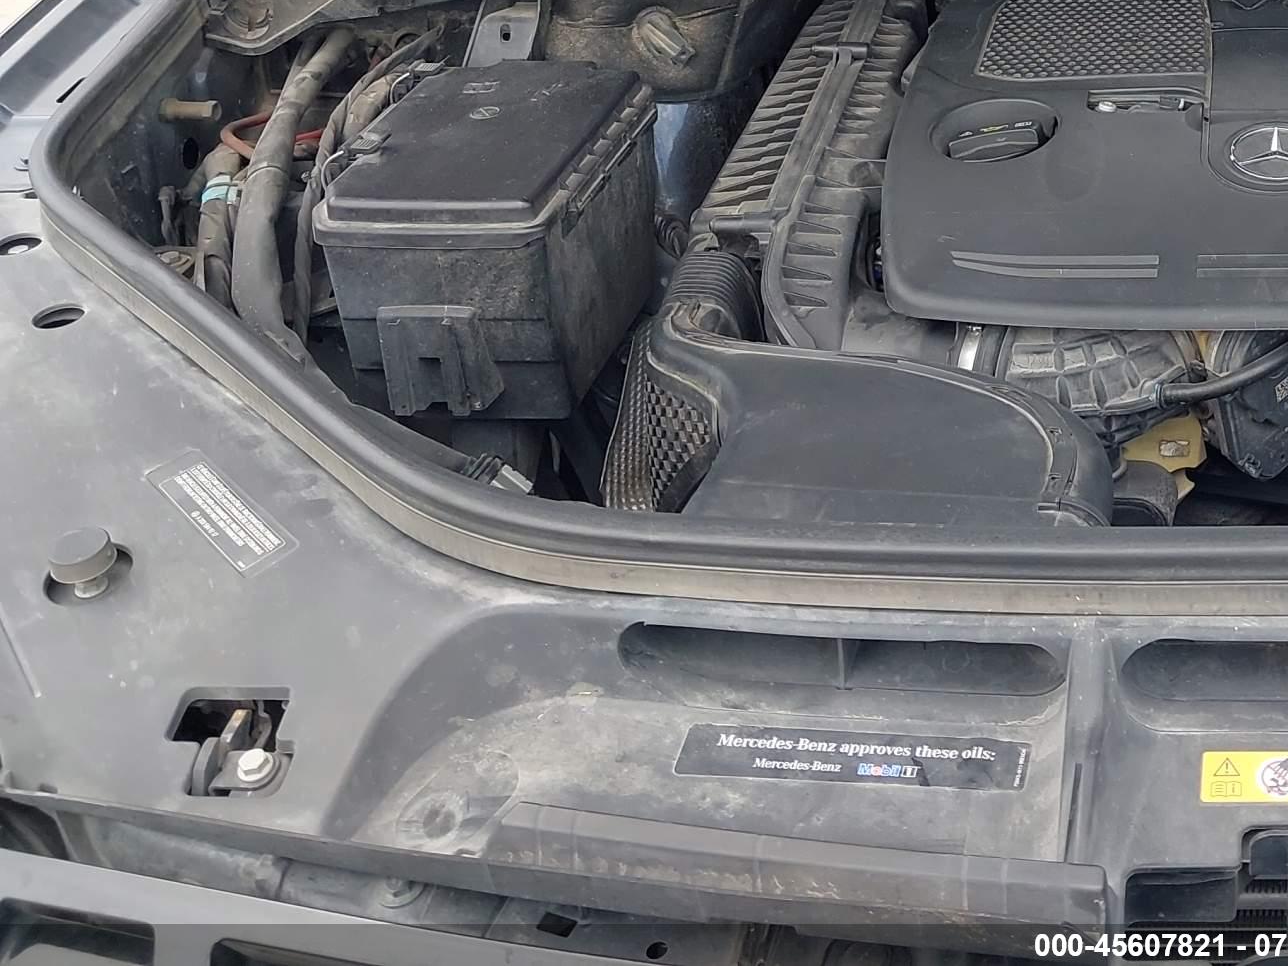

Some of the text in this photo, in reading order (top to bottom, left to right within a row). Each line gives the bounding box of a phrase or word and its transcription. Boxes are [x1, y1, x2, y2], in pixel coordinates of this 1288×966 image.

[716, 733, 997, 761] Mercedes-Benz approves these oils:
[752, 757, 842, 773] Mercedes-Benz
[857, 763, 901, 777] Mobil
